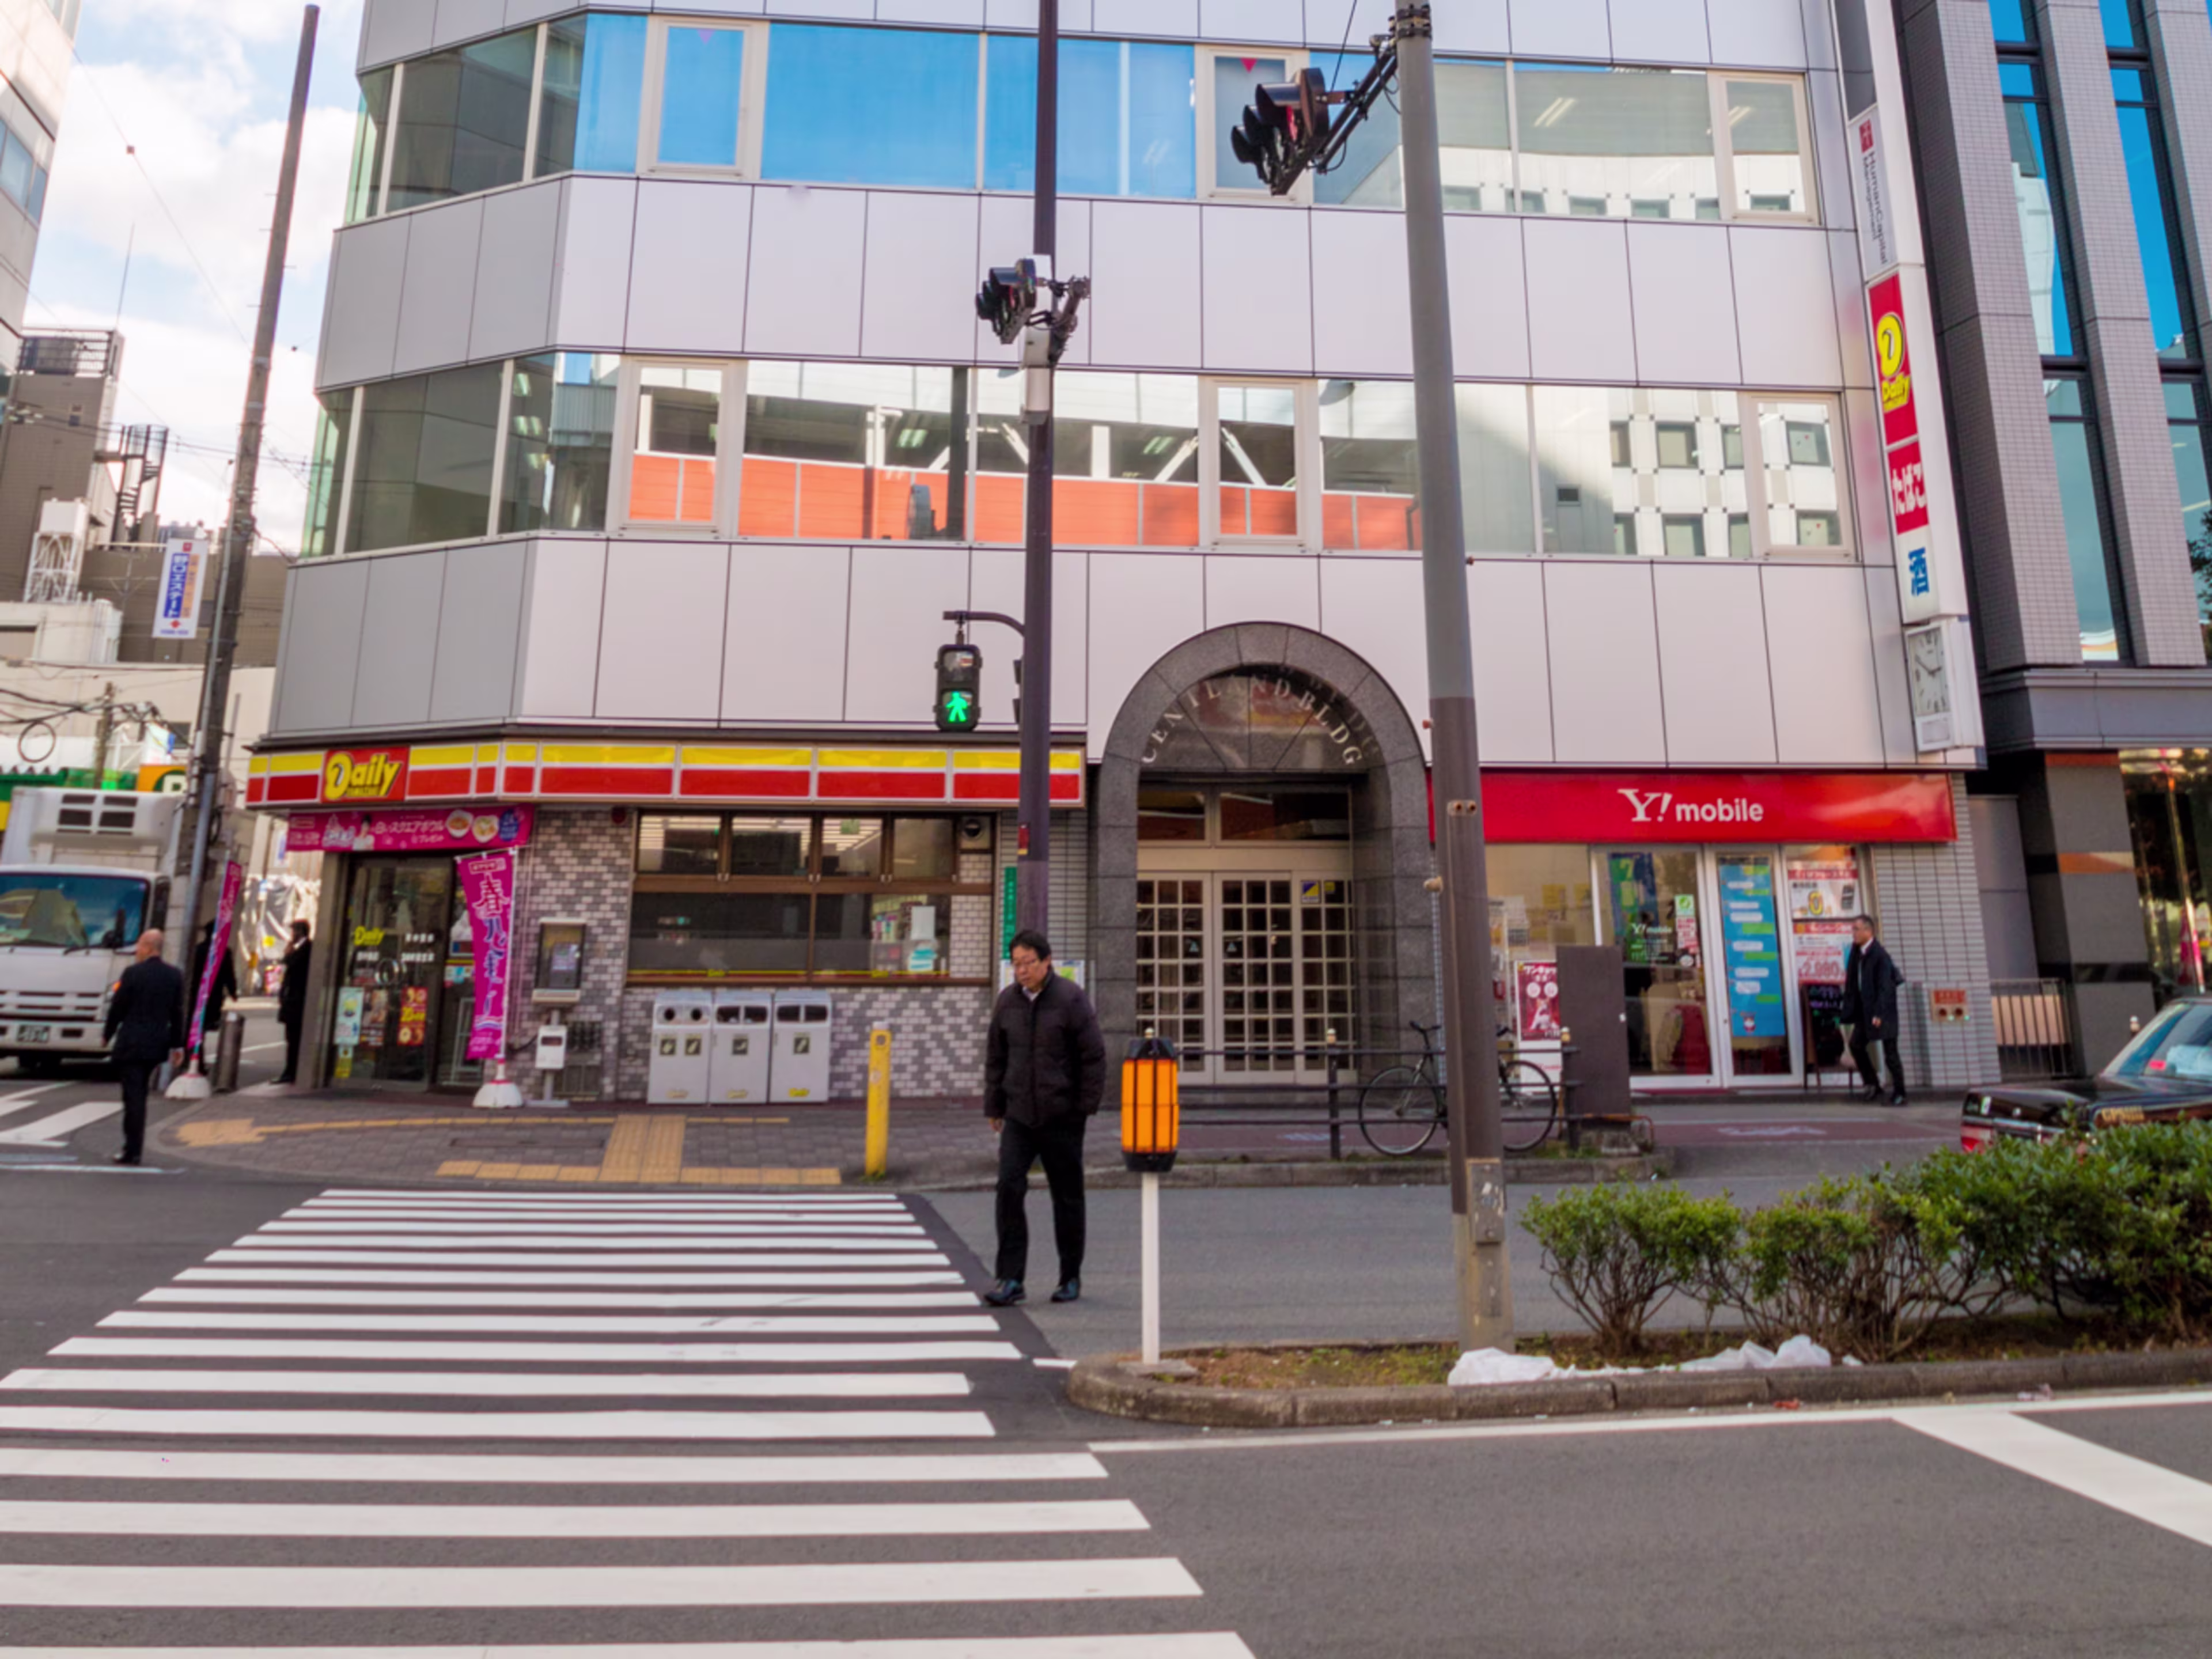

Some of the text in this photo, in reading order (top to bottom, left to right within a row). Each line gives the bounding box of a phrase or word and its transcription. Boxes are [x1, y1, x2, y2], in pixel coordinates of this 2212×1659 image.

[1882, 372, 1910, 406] Daily
[1892, 462, 1927, 515] たばこ
[1908, 546, 1930, 596] 酒
[1298, 690, 1363, 765] BLDG
[325, 752, 402, 800] Daily
